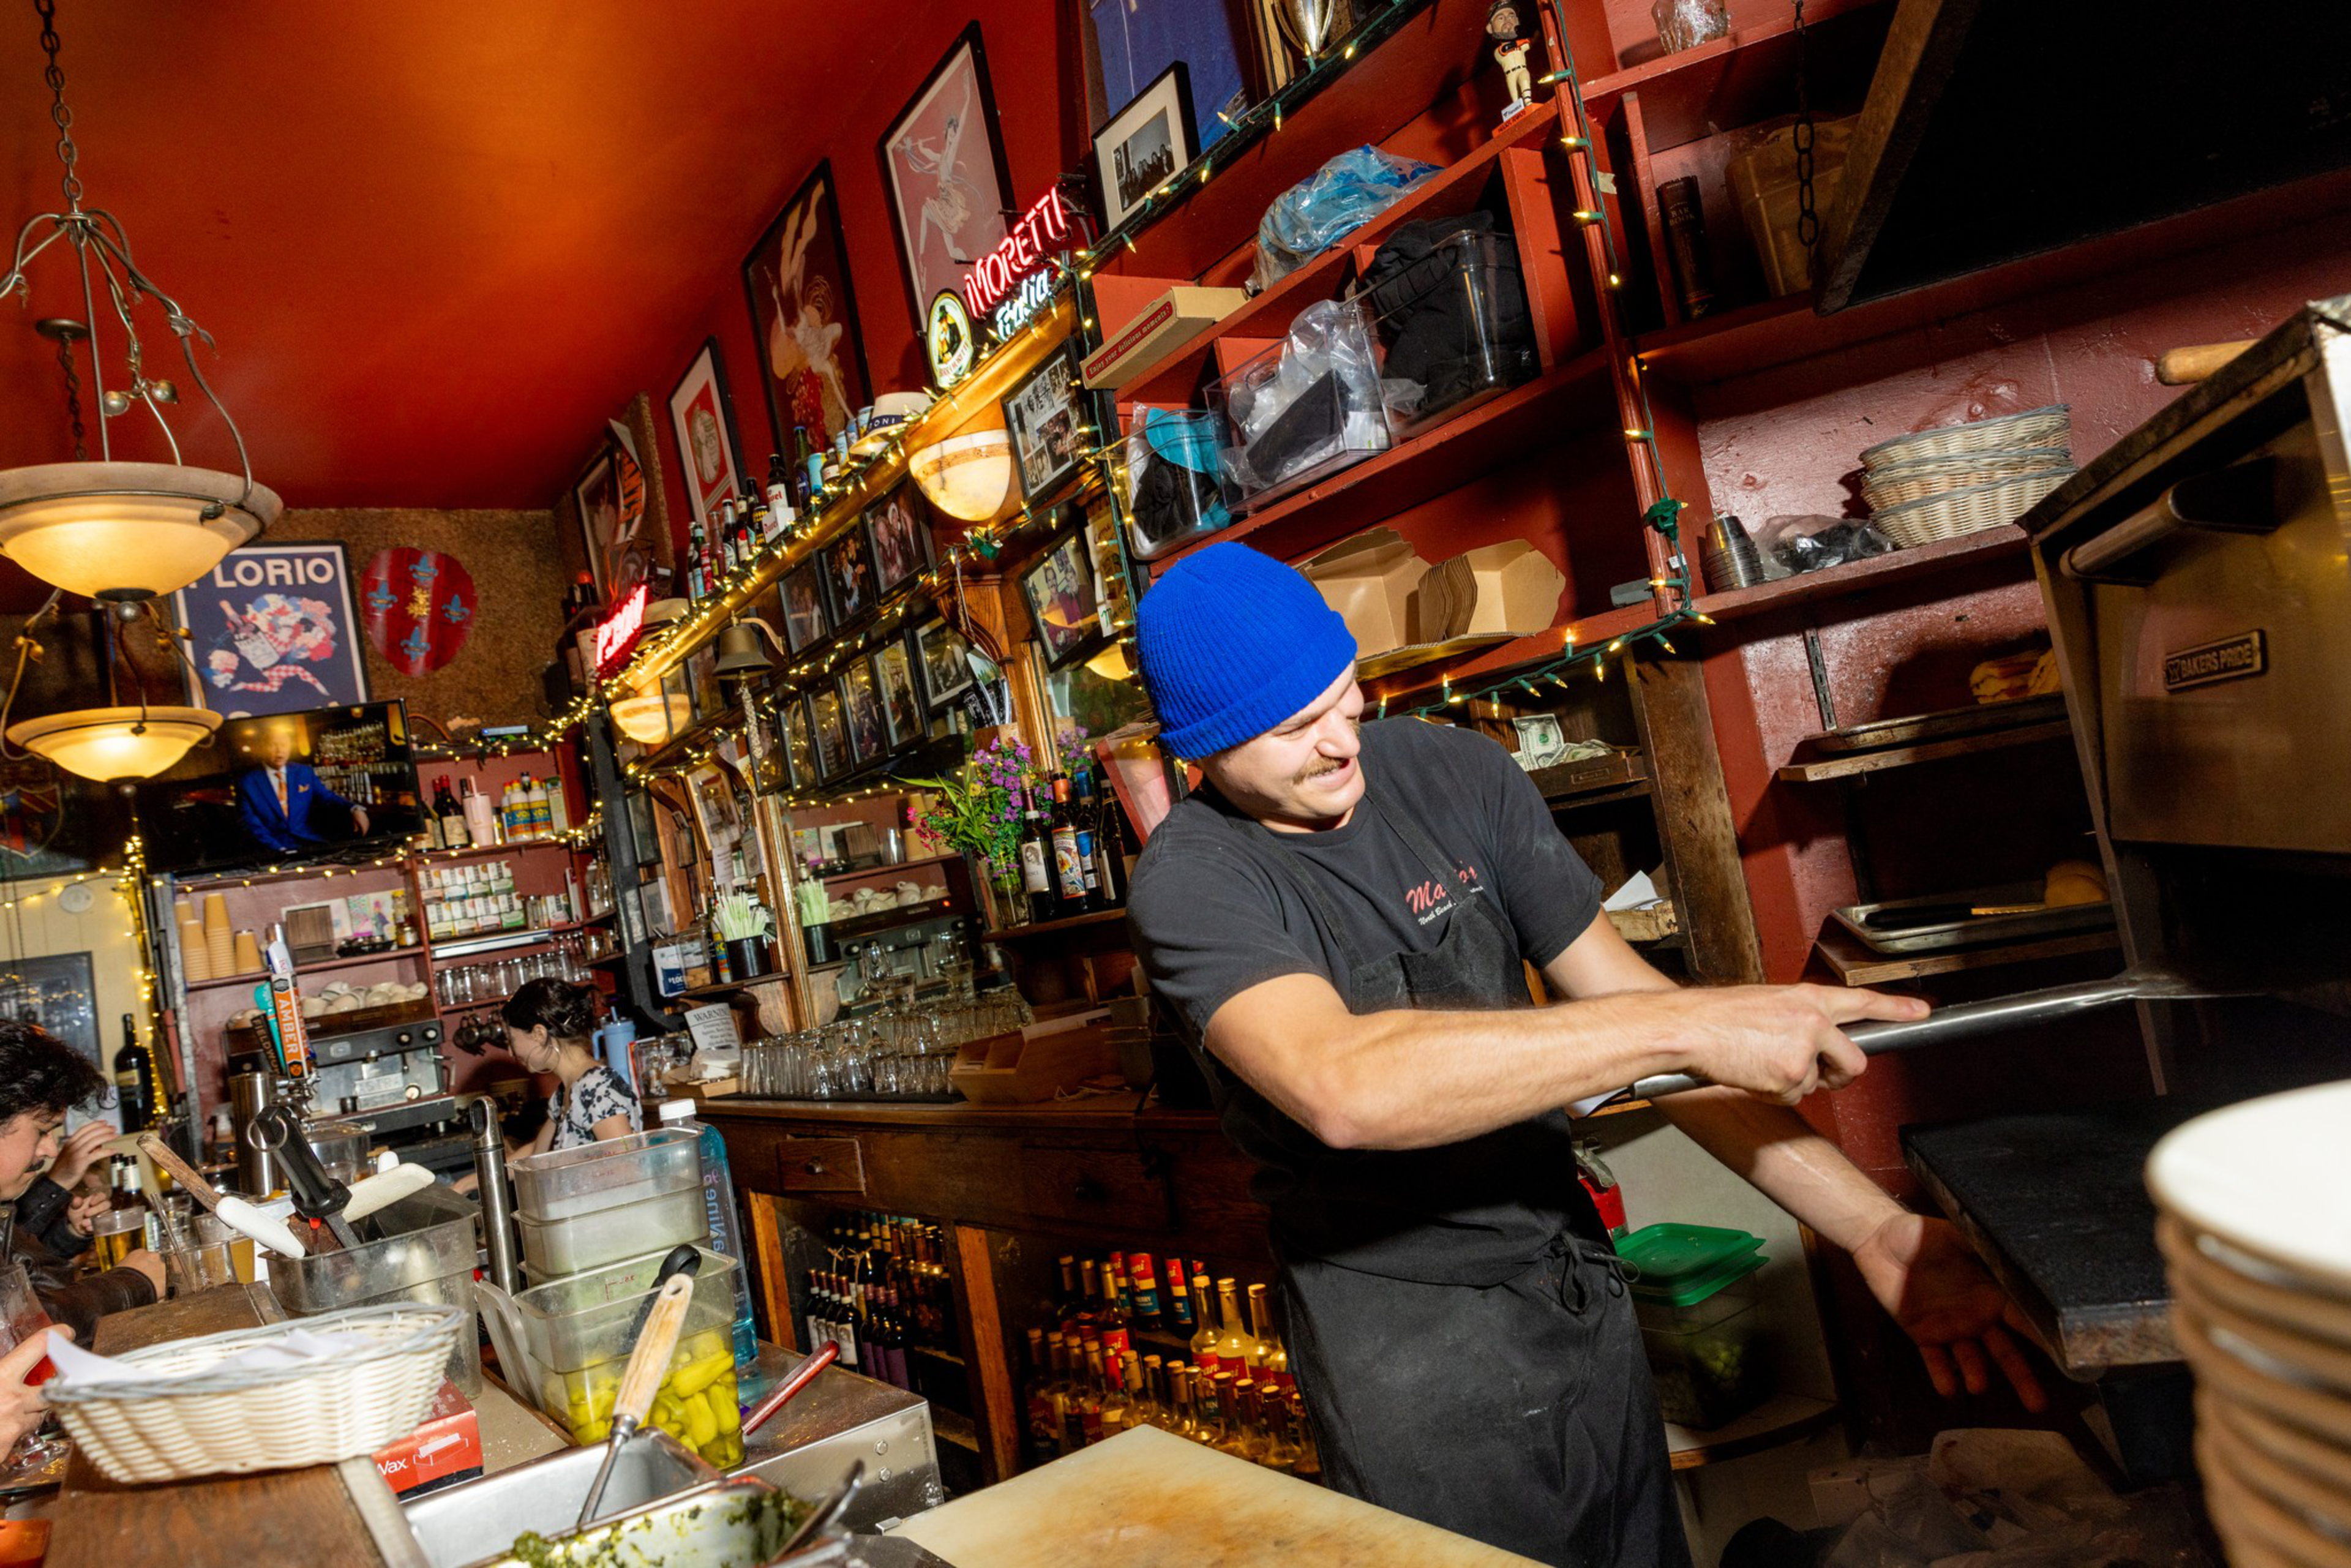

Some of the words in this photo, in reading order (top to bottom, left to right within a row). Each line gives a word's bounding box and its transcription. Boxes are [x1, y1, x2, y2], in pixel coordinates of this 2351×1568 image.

[964, 186, 1066, 318] MORETTI
[1089, 361, 1104, 375] Enjoy
[1105, 350, 1117, 364] your
[1118, 331, 1142, 352] delicious
[189, 557, 334, 589] LORIO
[2181, 651, 2219, 678] BAKERS
[2219, 642, 2252, 669] PRIDE
[1418, 910, 1436, 926] North
[1435, 900, 1453, 916] Beach
[279, 999, 299, 1054] AMBER
[693, 1008, 730, 1022] WARNIN
[252, 1018, 280, 1076] FIELDWO
